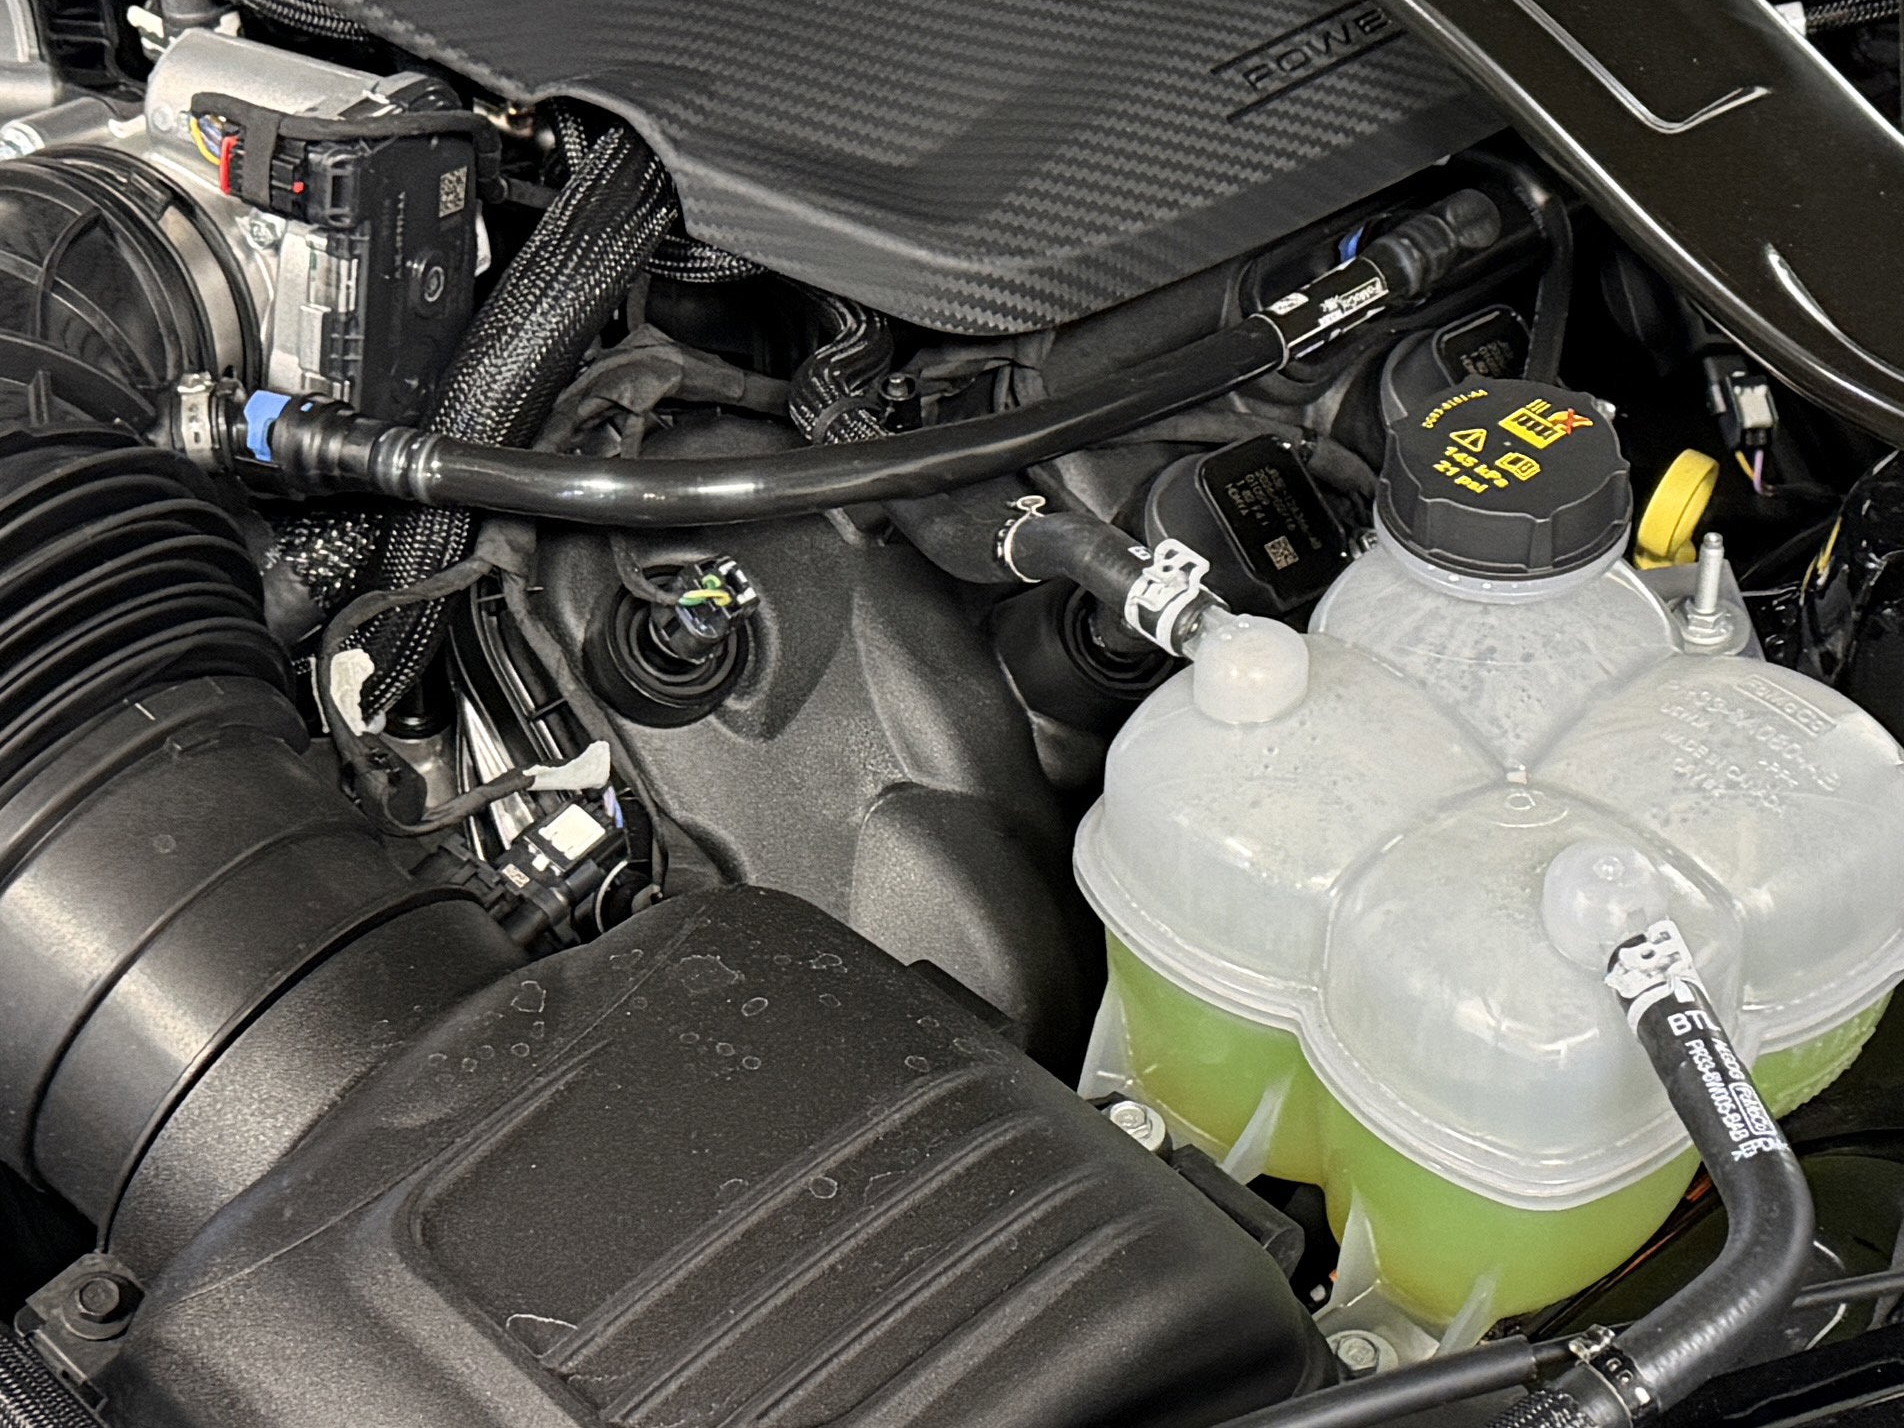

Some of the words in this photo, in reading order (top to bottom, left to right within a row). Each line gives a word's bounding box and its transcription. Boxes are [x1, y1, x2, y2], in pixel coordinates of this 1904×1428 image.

[1243, 6, 1394, 92] POWE
[1432, 459, 1461, 477] 21
[1453, 474, 1489, 494] psi
[1444, 445, 1479, 468] 145
[1473, 463, 1509, 489] kPa
